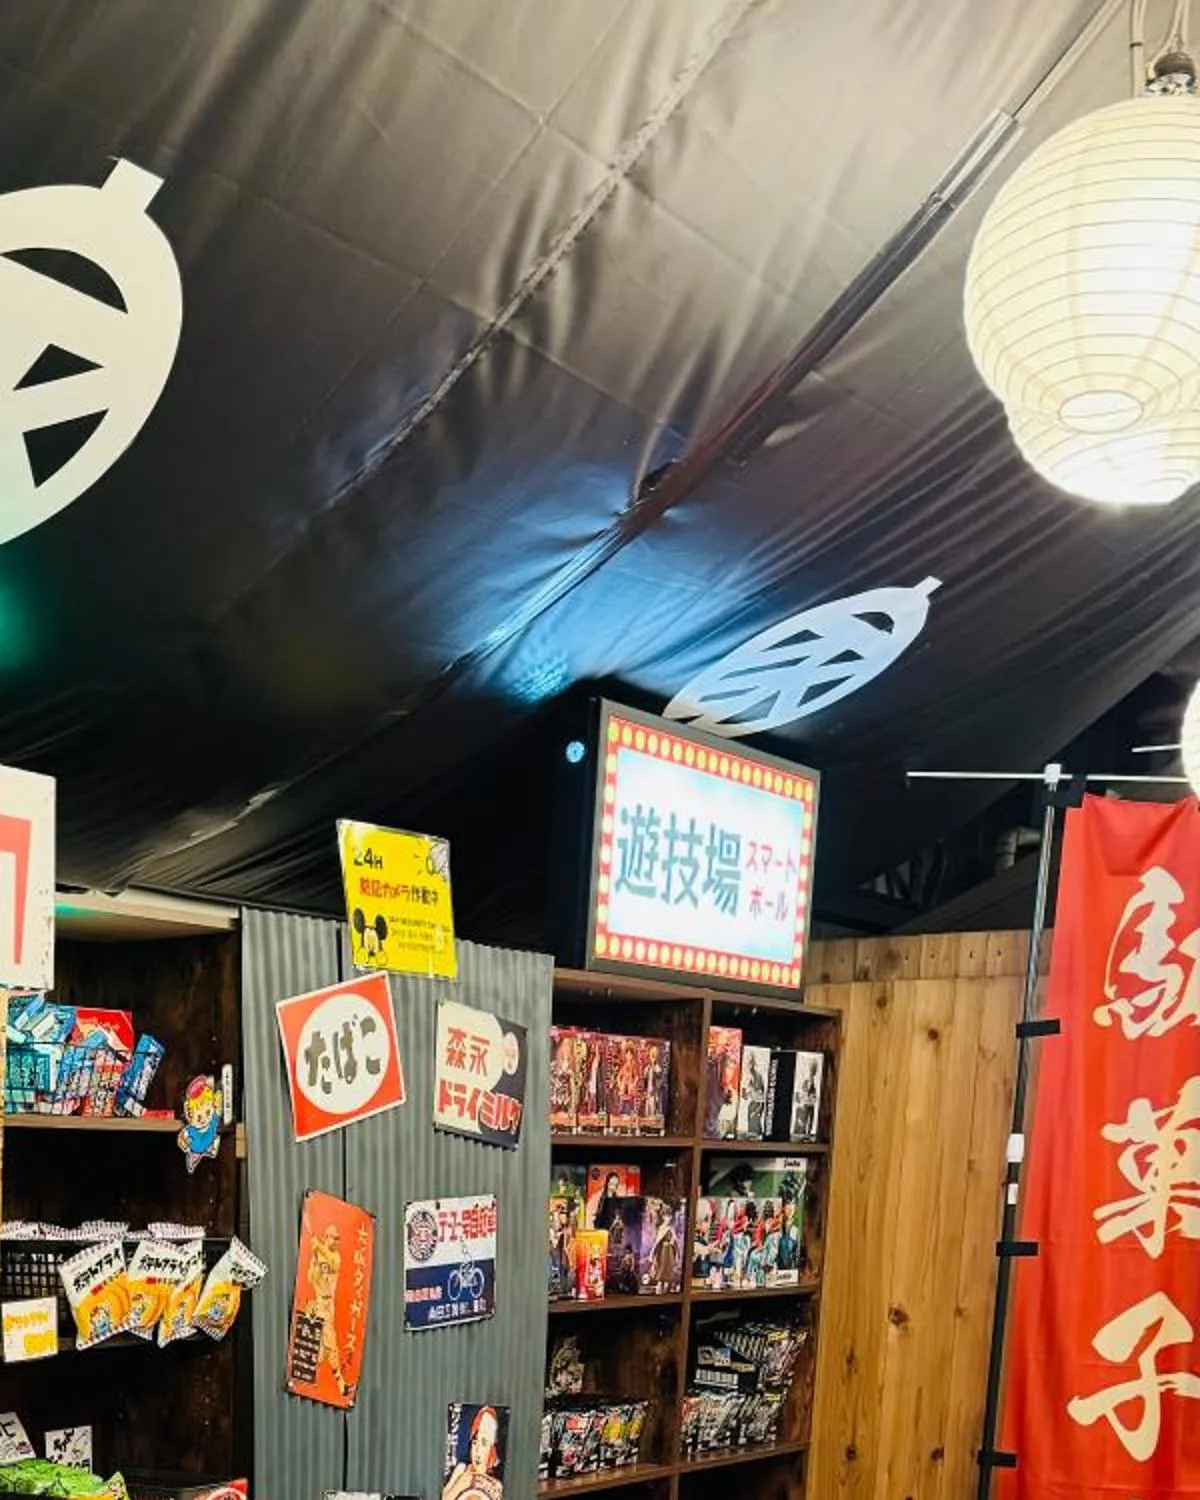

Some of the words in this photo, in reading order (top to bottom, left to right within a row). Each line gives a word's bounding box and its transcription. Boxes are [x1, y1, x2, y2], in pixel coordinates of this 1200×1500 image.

[615, 803, 742, 917] 遊技場
[746, 841, 797, 882] スマート
[305, 1014, 381, 1094] たばこ
[446, 1027, 490, 1077] 森永
